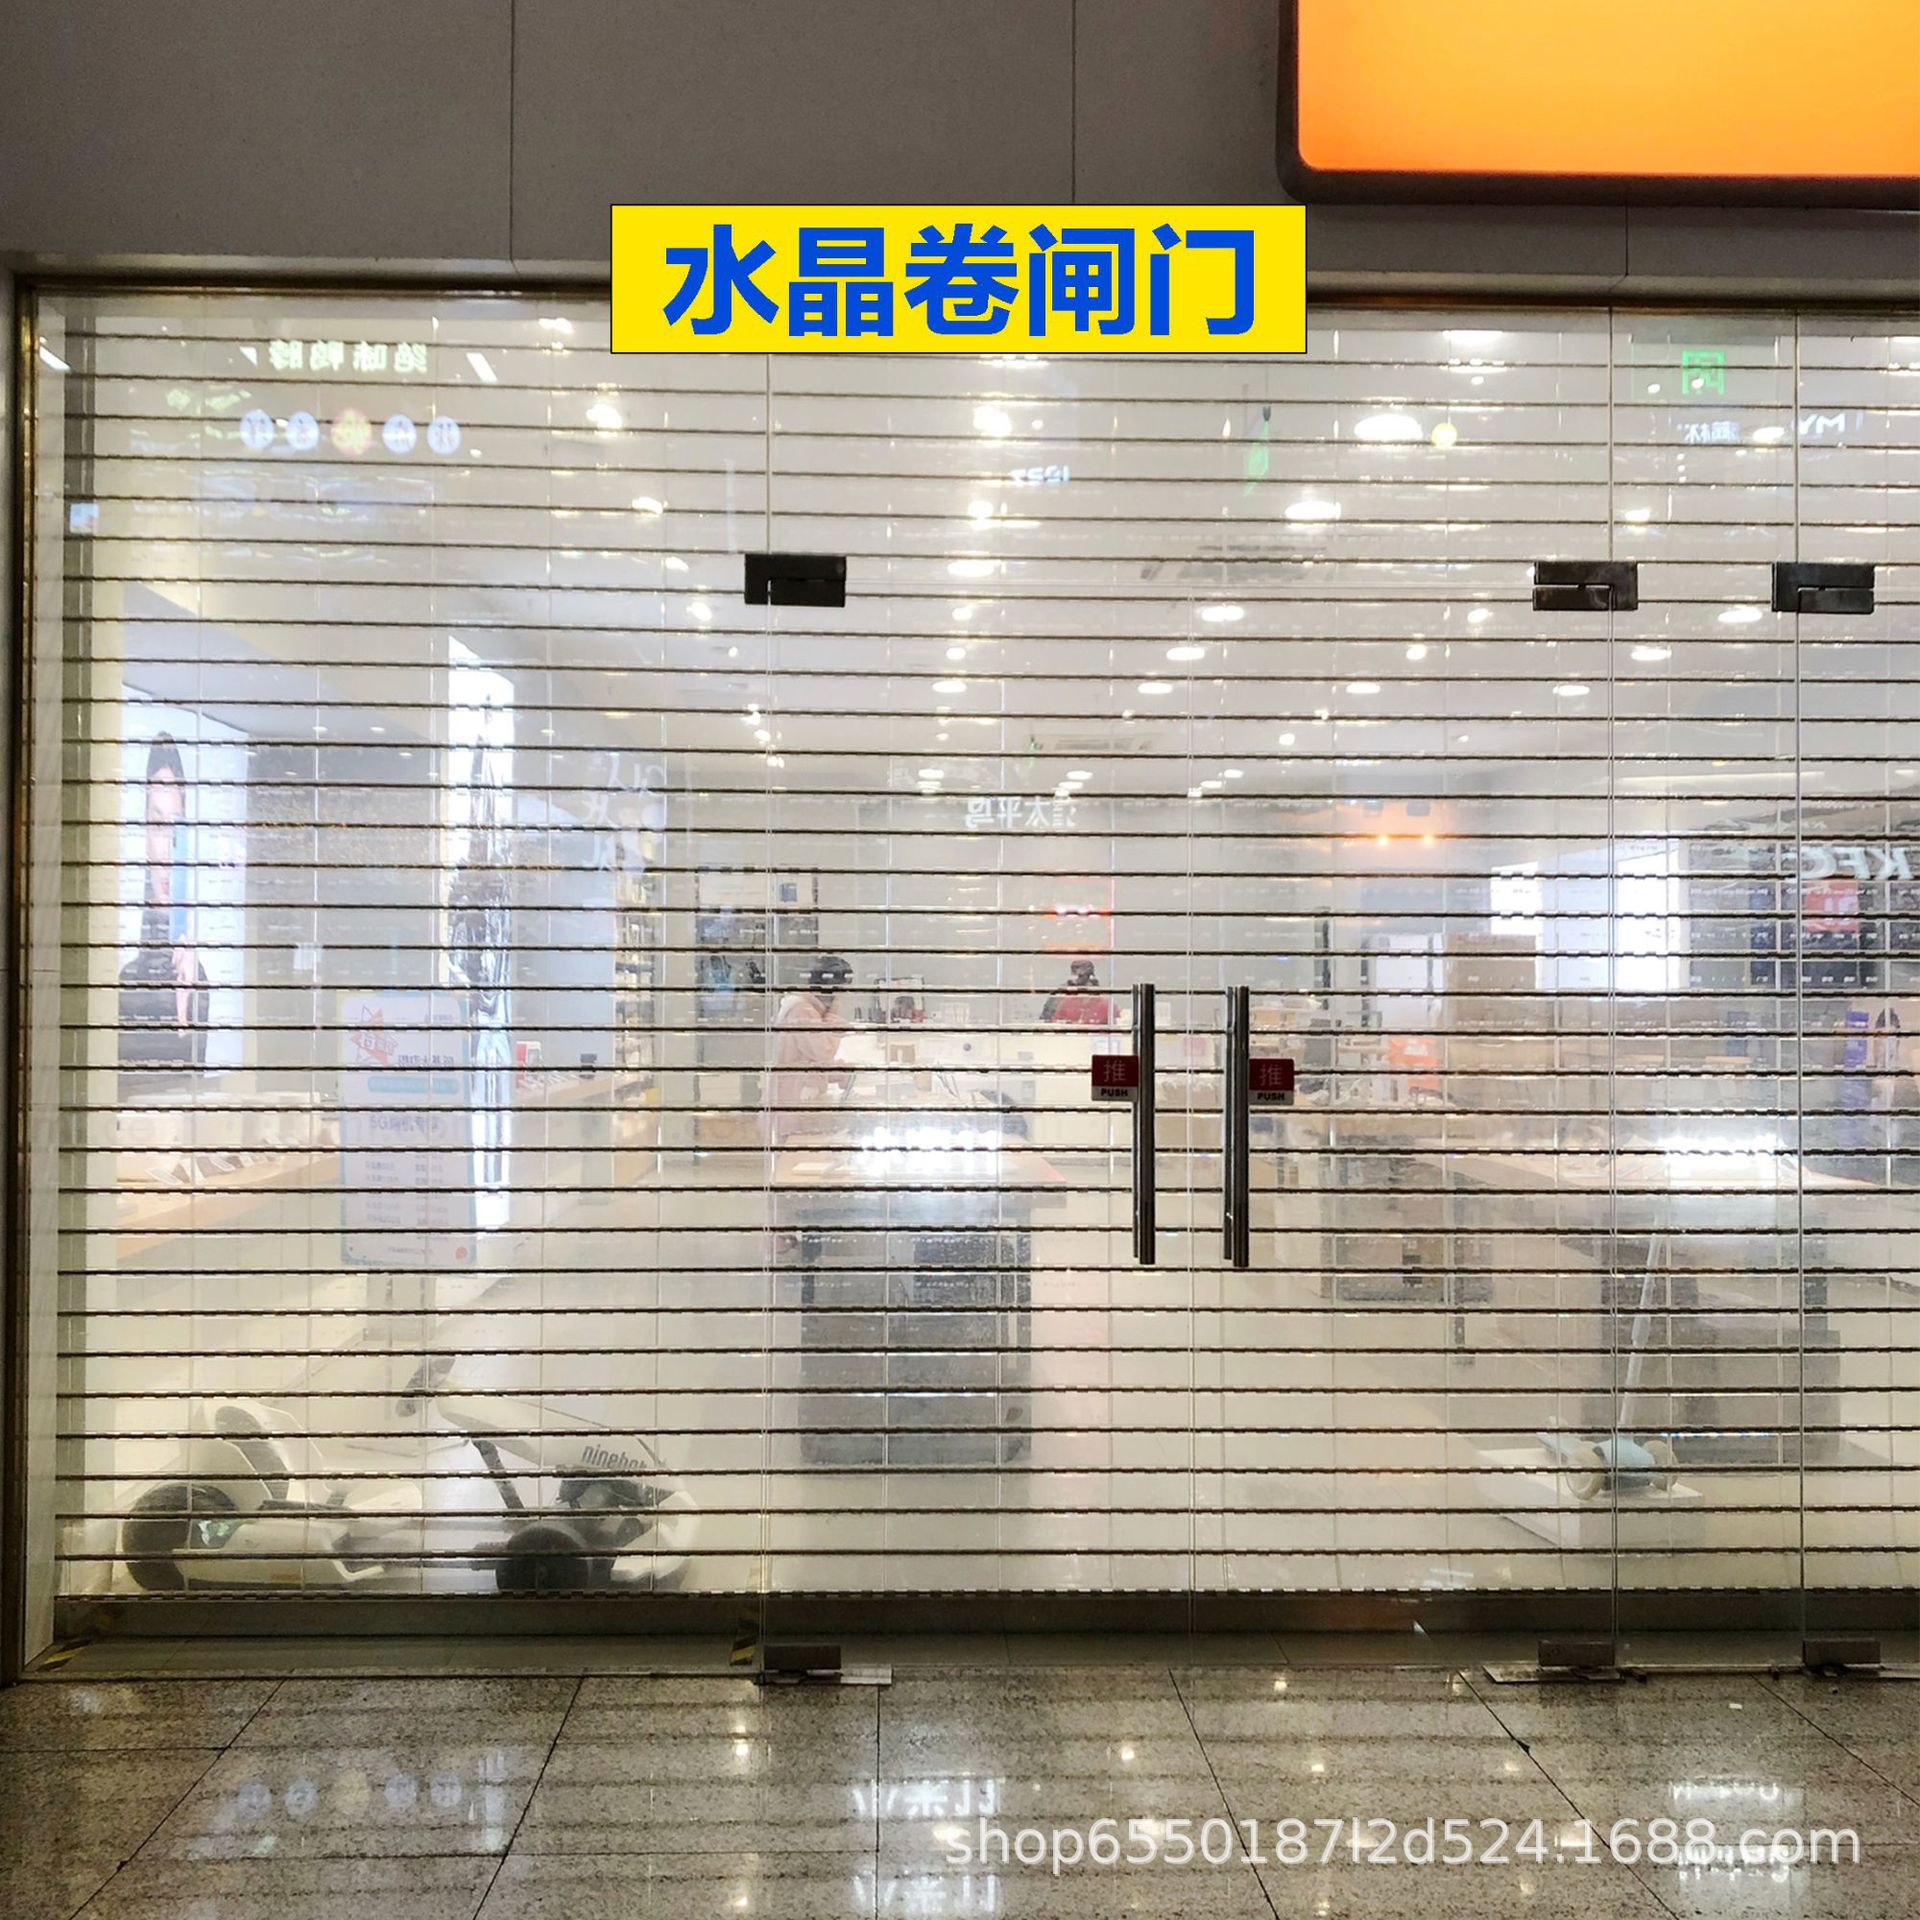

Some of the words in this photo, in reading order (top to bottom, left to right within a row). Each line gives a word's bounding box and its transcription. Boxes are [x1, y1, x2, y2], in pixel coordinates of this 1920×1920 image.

[1103, 1059, 1128, 1083] 推
[1258, 1063, 1283, 1087] 推
[1100, 1088, 1129, 1097] PUSH
[1256, 1092, 1286, 1101] PUSH
